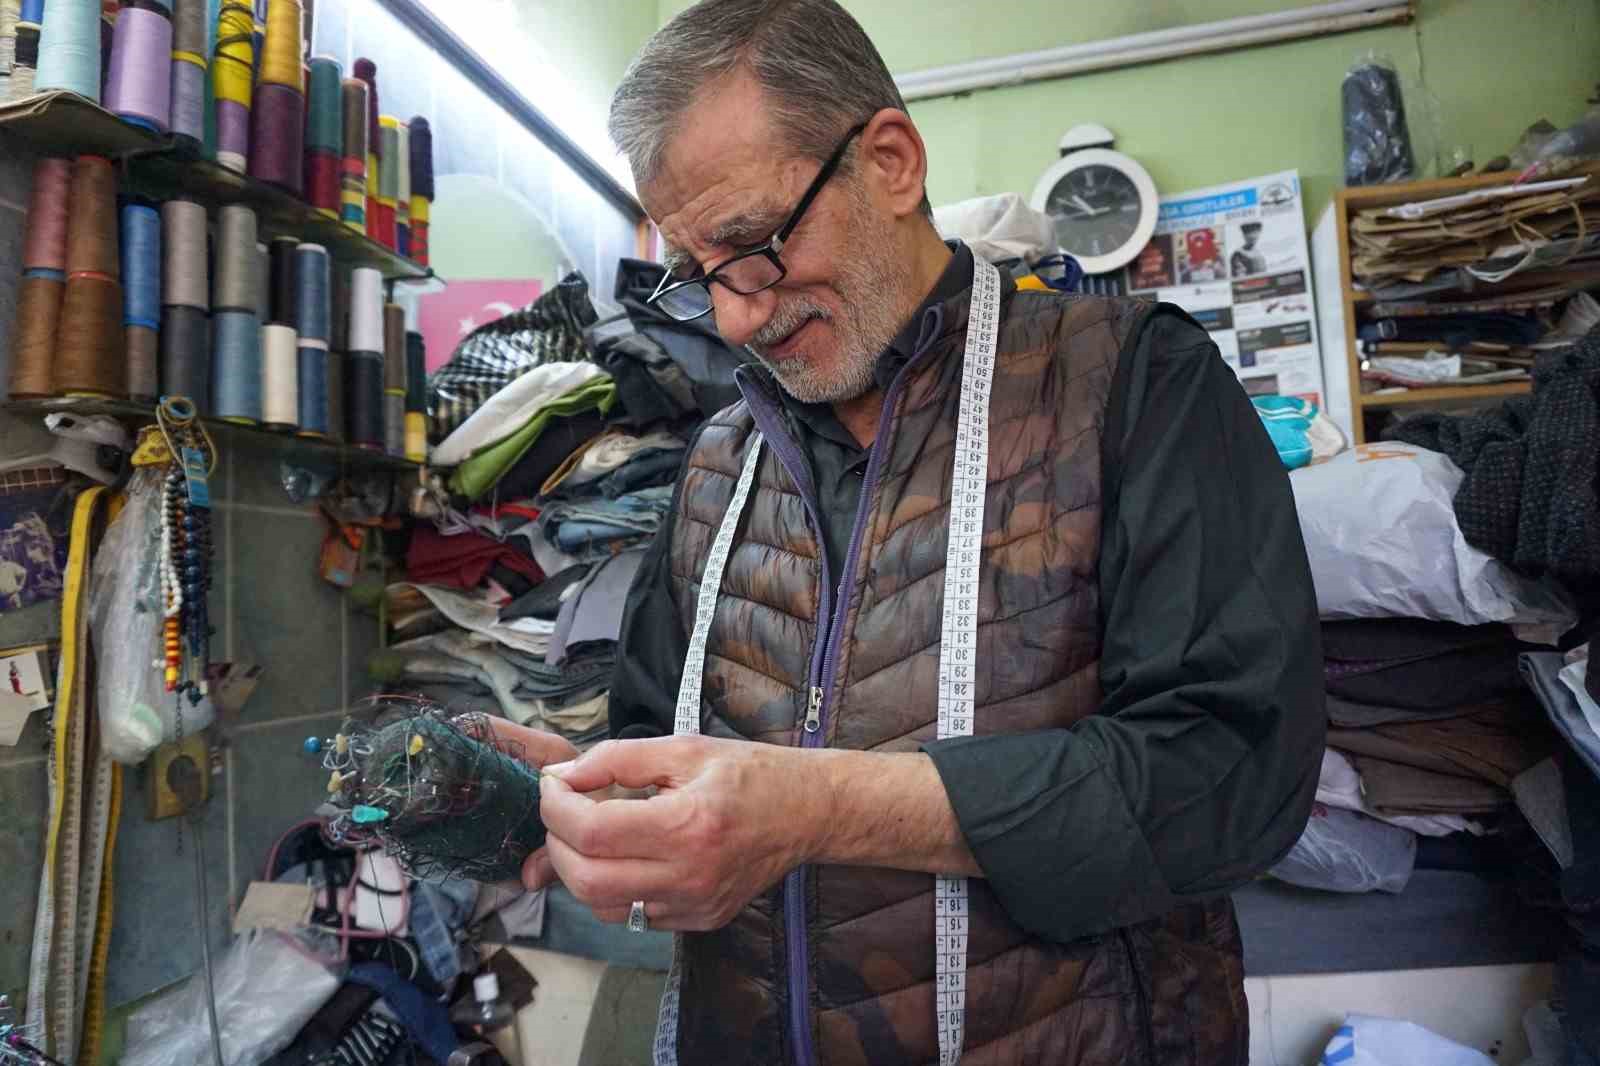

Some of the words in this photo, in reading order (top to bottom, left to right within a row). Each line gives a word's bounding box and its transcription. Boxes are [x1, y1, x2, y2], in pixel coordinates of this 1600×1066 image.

[979, 344, 990, 354] 52
[976, 367, 987, 377] 50
[974, 381, 986, 391] 49
[972, 404, 983, 414] 47
[969, 452, 981, 462] 43
[968, 465, 980, 476] 42
[968, 479, 980, 490] 41
[965, 493, 978, 503] 40
[964, 508, 977, 518] 39
[963, 522, 976, 533] 38
[962, 537, 975, 548] 37
[961, 552, 974, 563] 36
[960, 567, 973, 578] 35
[959, 583, 972, 594] 34
[958, 599, 971, 611] 33
[957, 615, 970, 627] 32
[957, 632, 969, 644] 31
[955, 648, 968, 661] 30
[954, 665, 968, 679] 29
[953, 683, 968, 696] 28
[953, 701, 967, 713] 27
[677, 720, 689, 730] 116
[952, 718, 966, 731] 26
[949, 899, 961, 912] 16
[950, 918, 962, 931] 15
[949, 937, 961, 950] 14
[949, 955, 961, 968] 13
[949, 974, 960, 988] 12
[950, 992, 960, 1006] 11
[949, 1012, 960, 1026] 10
